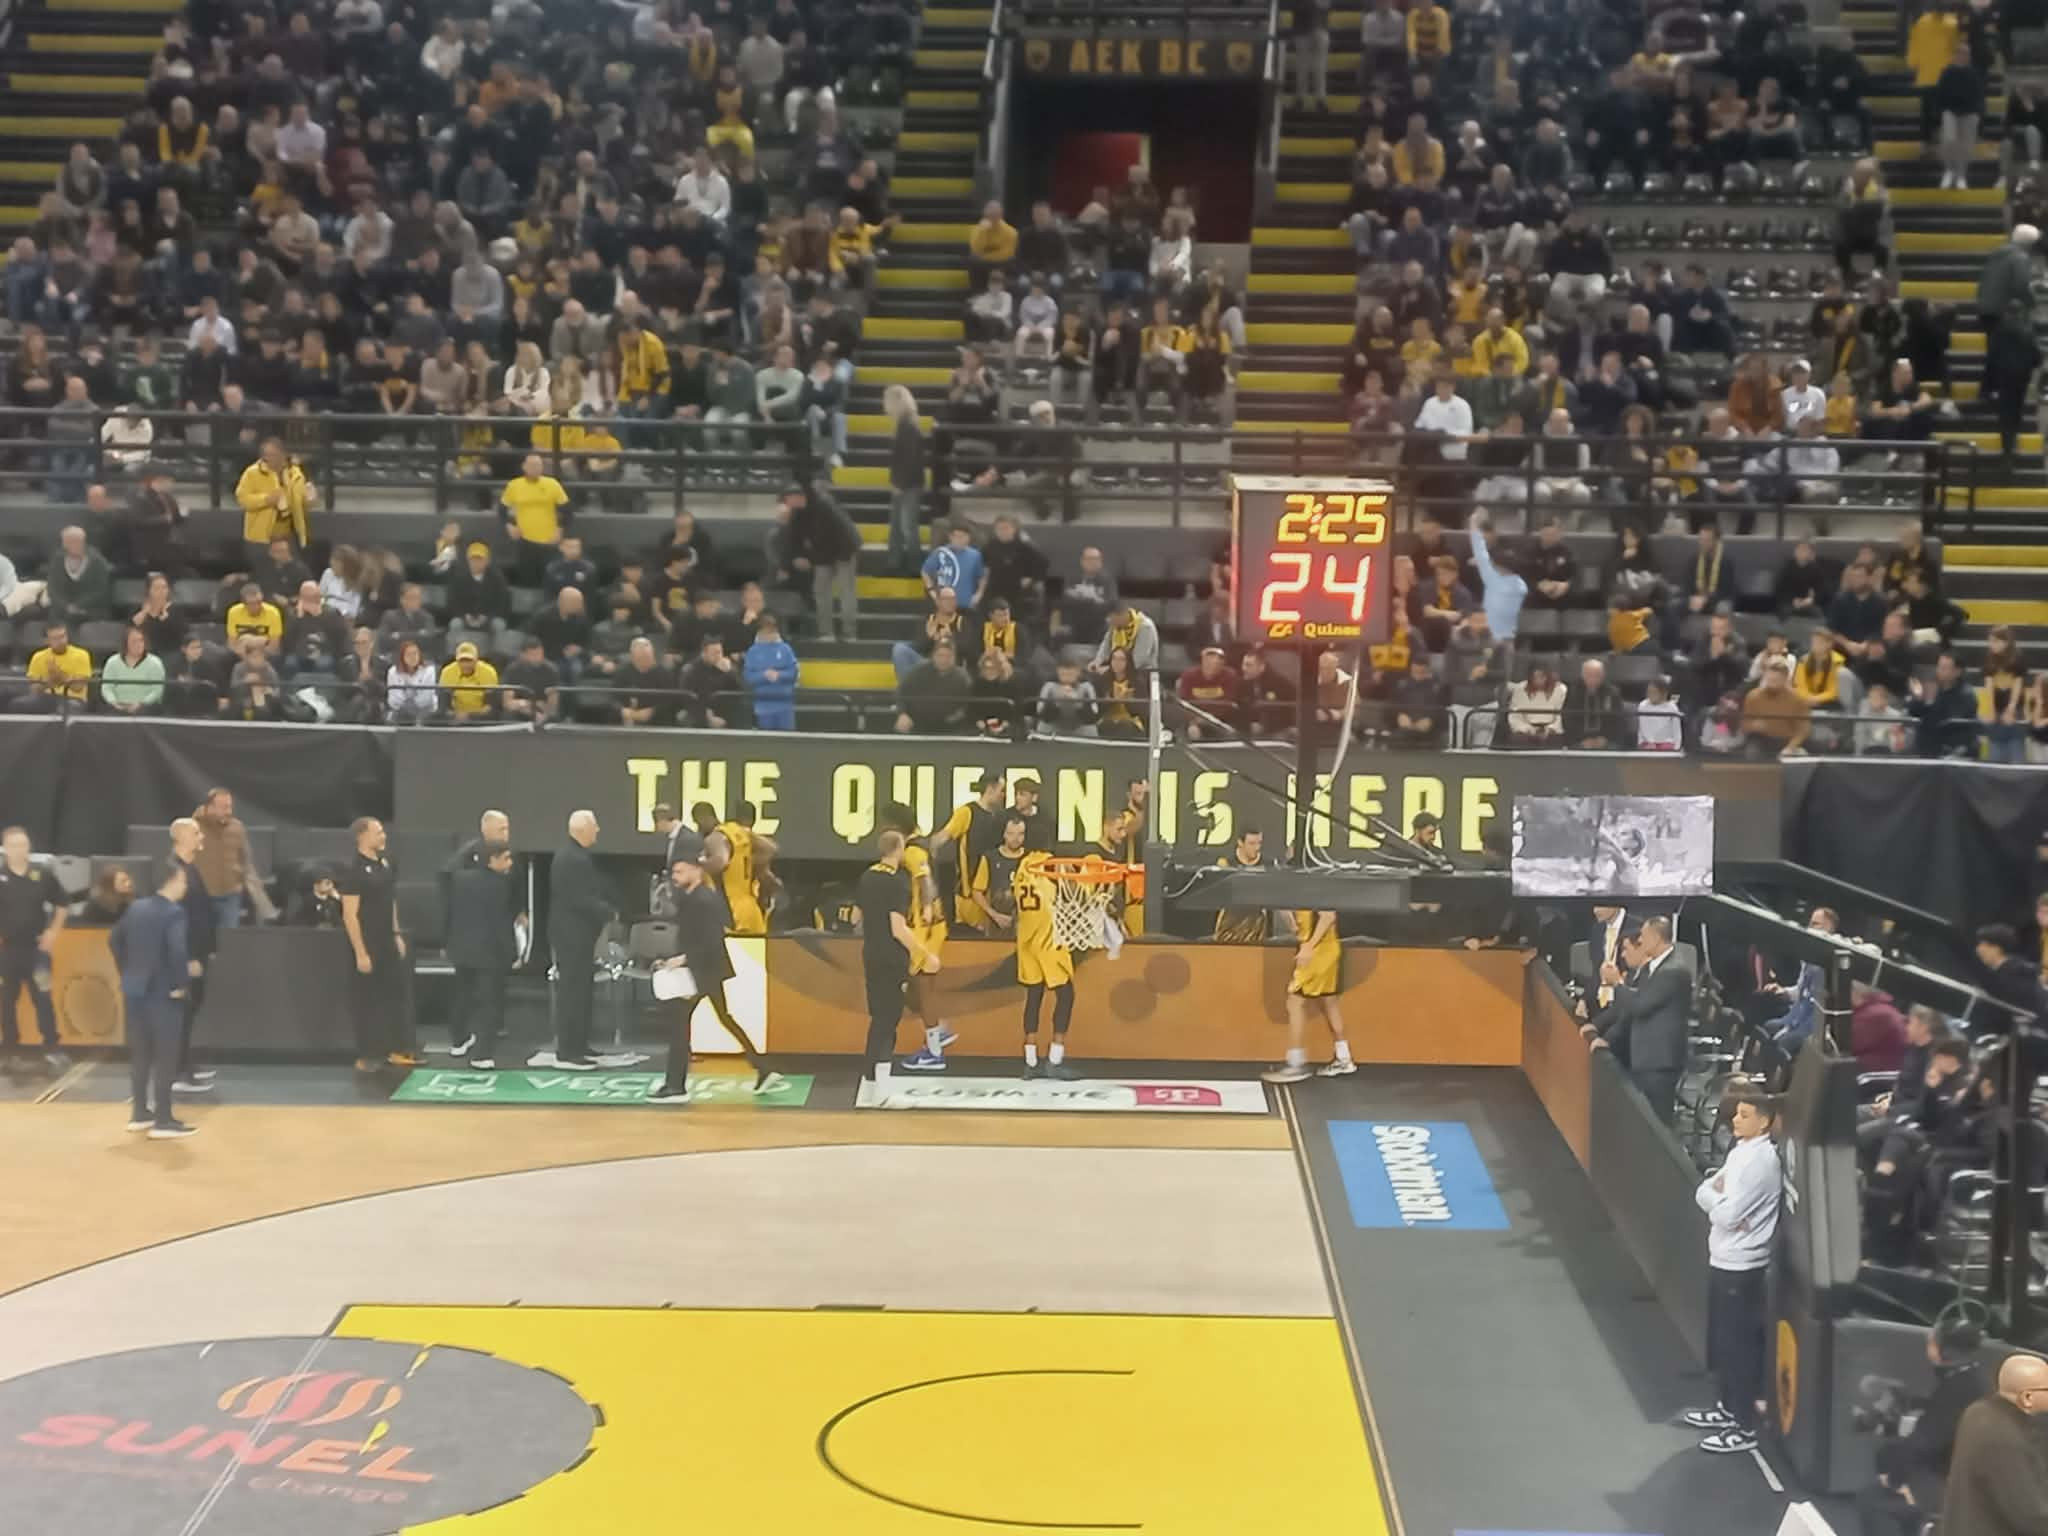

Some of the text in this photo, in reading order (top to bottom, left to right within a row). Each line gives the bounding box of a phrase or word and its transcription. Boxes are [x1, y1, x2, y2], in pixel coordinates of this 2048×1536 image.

[1069, 38, 1208, 75] AEK BC
[1277, 493, 1388, 544] 2:25
[1258, 552, 1372, 622] 24
[626, 758, 781, 835] THE
[1158, 770, 1234, 846] IS
[1286, 773, 1500, 852] HERE
[1019, 884, 1041, 912] 25
[903, 1086, 1112, 1101] COSMTE
[17, 1413, 435, 1484] SUNEL
